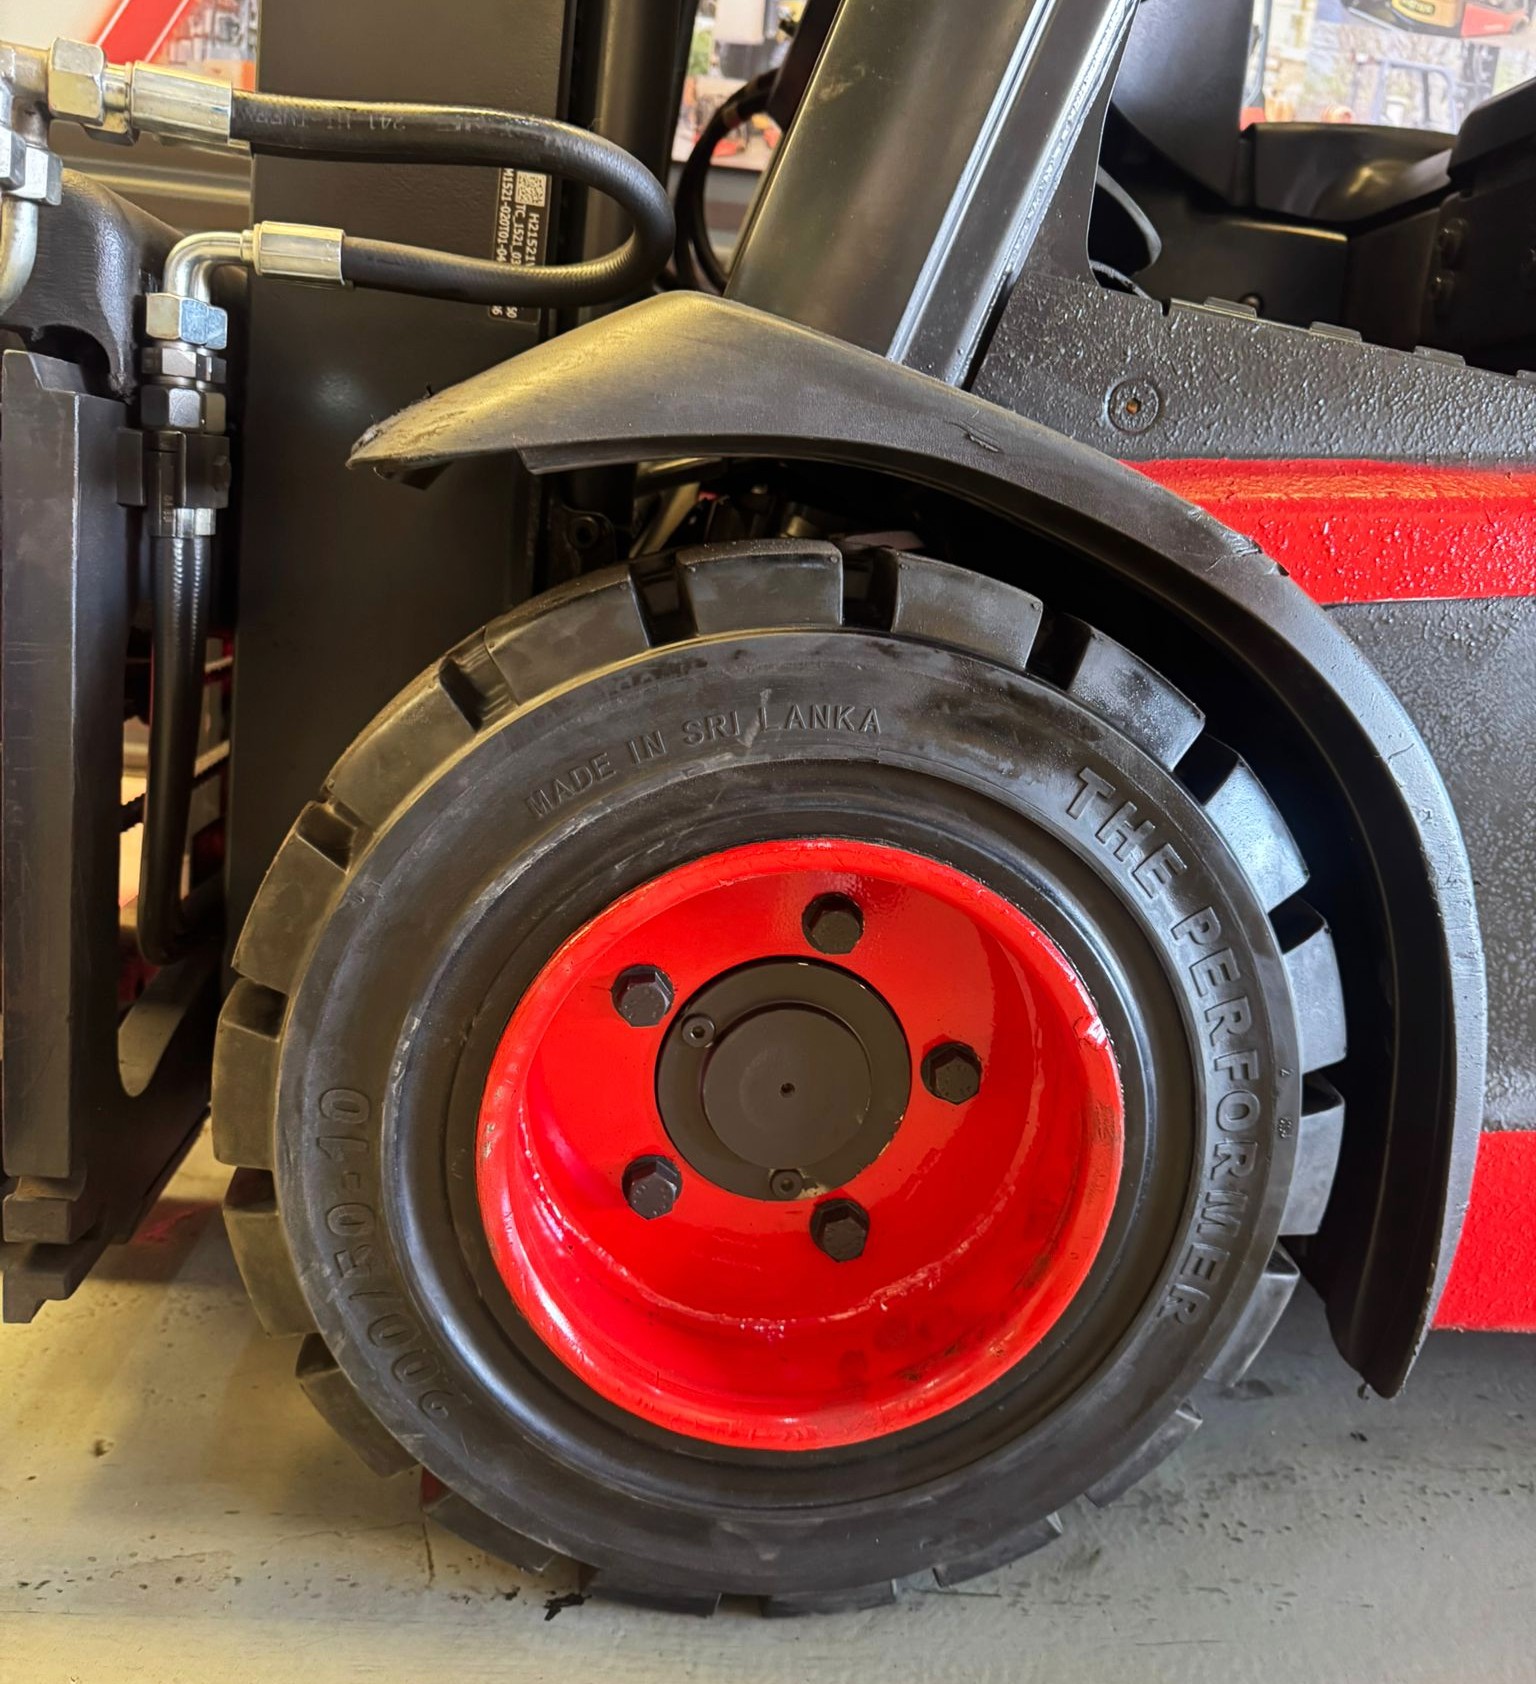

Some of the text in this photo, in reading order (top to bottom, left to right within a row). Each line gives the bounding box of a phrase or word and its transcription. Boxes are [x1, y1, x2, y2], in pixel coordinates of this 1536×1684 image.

[526, 703, 883, 819] MADE IN SRI LANKA
[1067, 766, 1262, 1327] THE PERFORMER
[316, 1088, 462, 1418] 200/50-10
